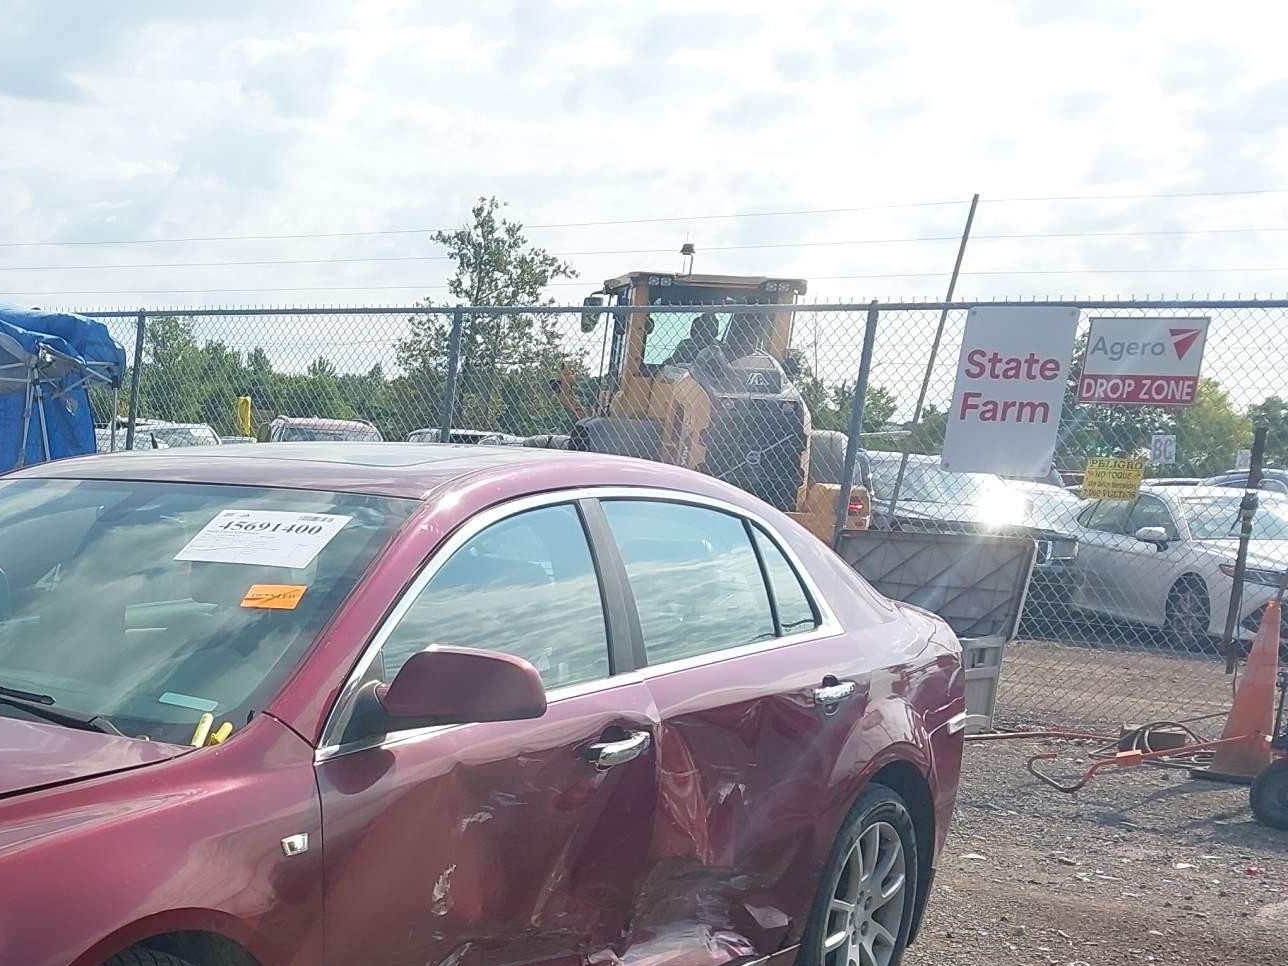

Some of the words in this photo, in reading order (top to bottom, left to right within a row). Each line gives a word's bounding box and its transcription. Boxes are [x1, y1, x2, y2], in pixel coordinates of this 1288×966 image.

[1090, 336, 1166, 361] Agero
[964, 350, 1061, 381] State
[1082, 378, 1136, 399] DROP
[1138, 379, 1194, 401] ZONE
[959, 391, 1050, 424] Farm
[1089, 459, 1143, 470] PELIGRO
[219, 520, 323, 536] 45691400
